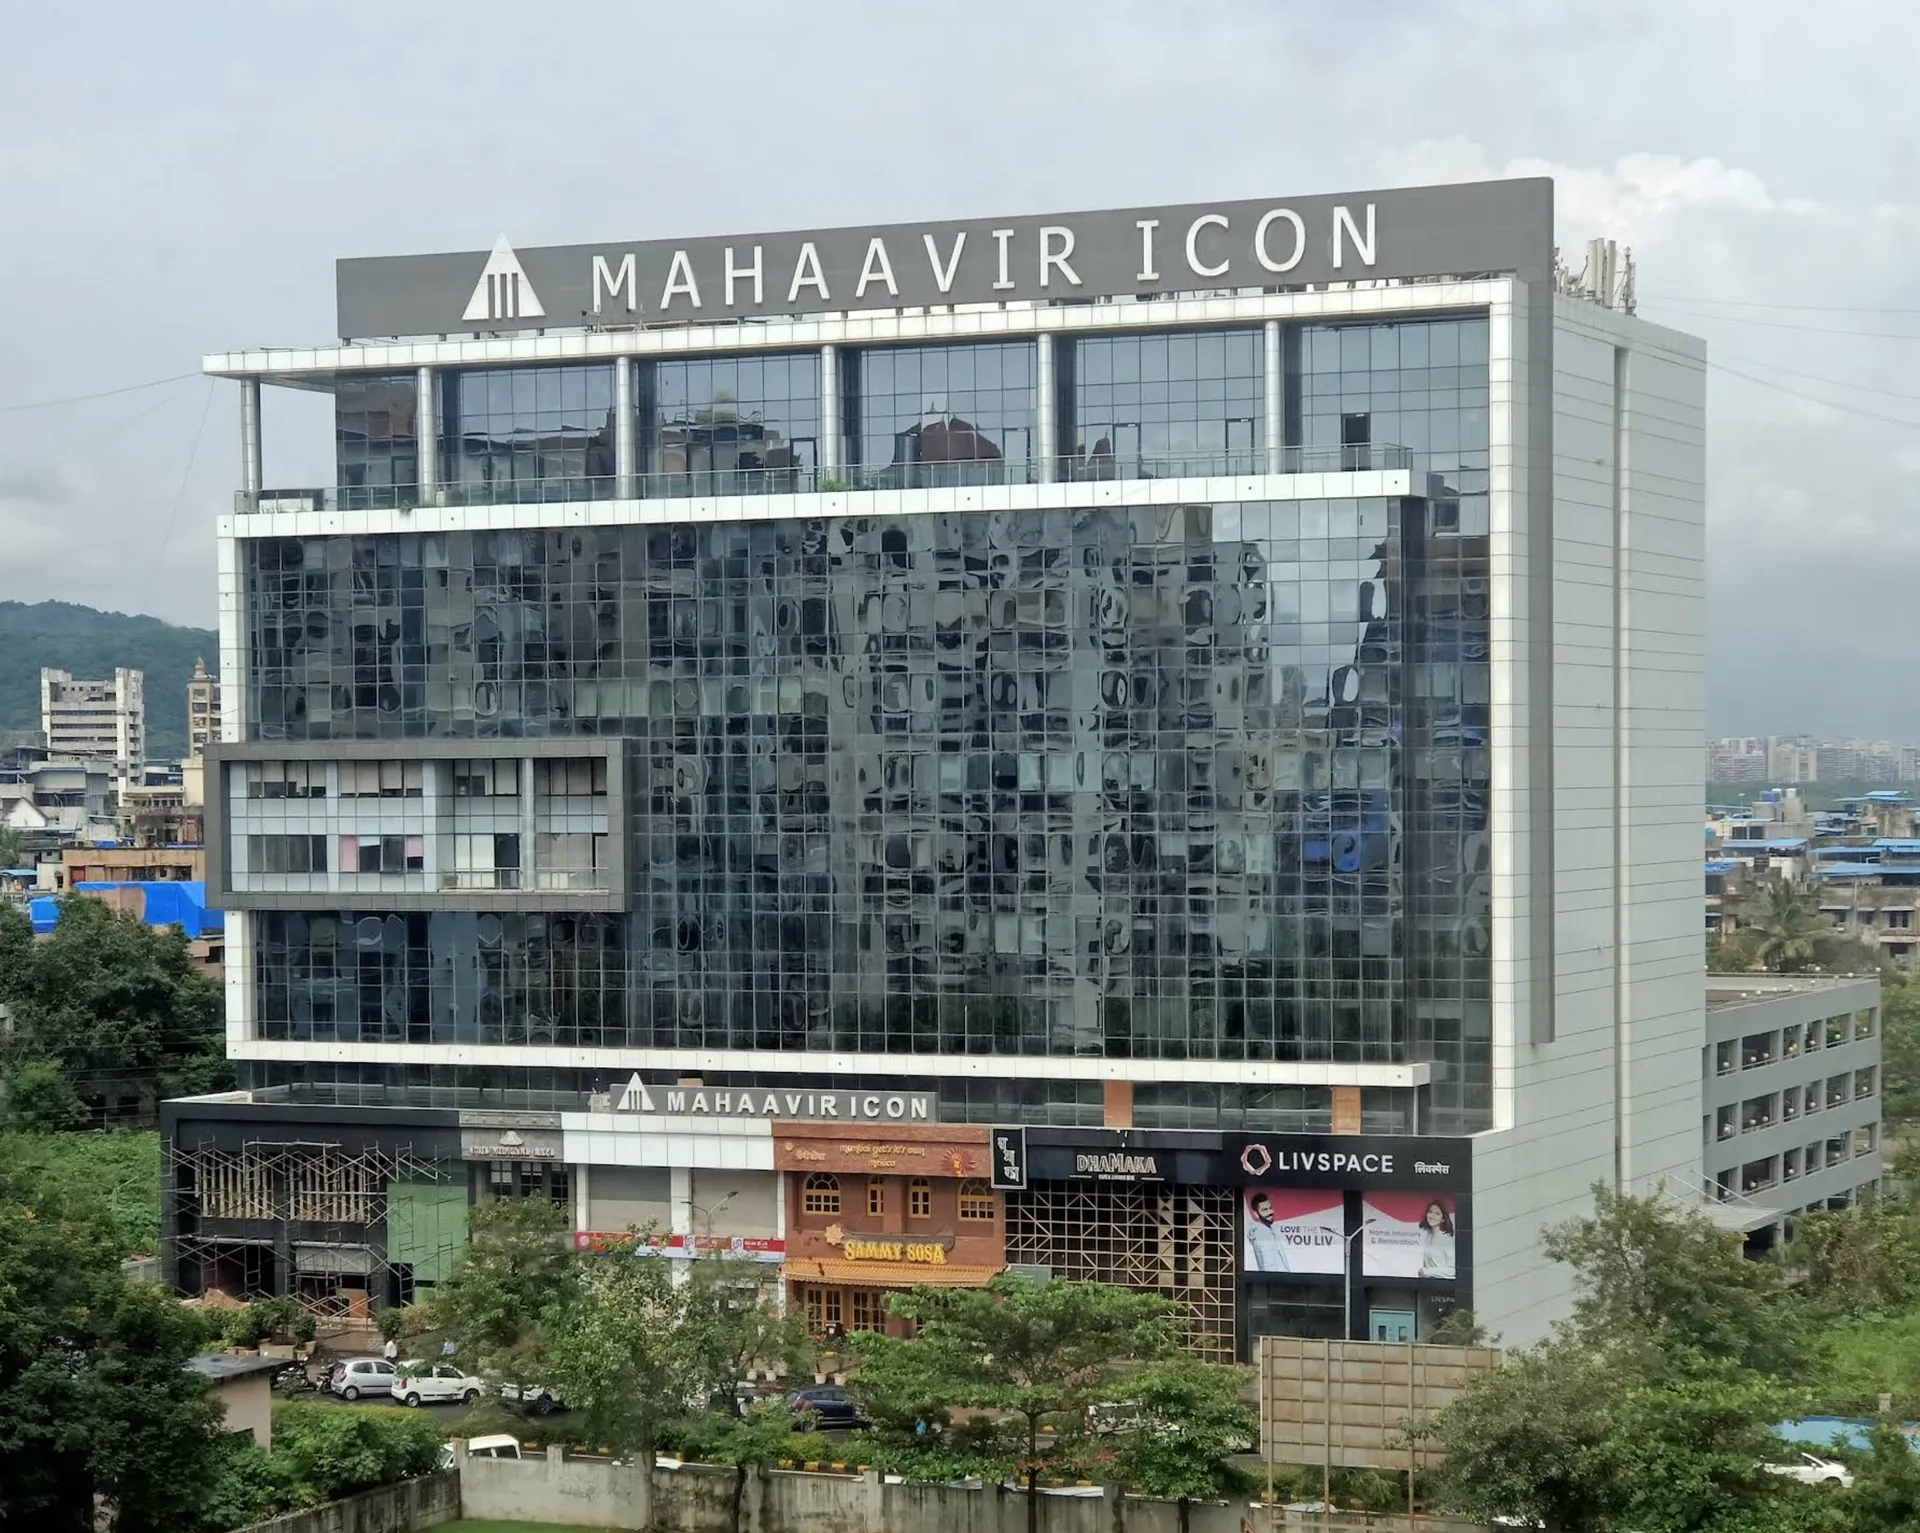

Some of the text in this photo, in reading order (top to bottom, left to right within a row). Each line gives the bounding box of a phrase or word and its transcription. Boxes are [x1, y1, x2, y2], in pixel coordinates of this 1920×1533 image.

[592, 203, 1377, 312] MAHAAVIR ICON
[667, 1091, 927, 1119] MAHAAVIR ICON
[1278, 1151, 1394, 1173] LIVSPACE
[1280, 1225, 1301, 1233] LOVE
[1285, 1234, 1333, 1246] YOU LIV
[844, 1239, 948, 1265] SAMMY SOSA
